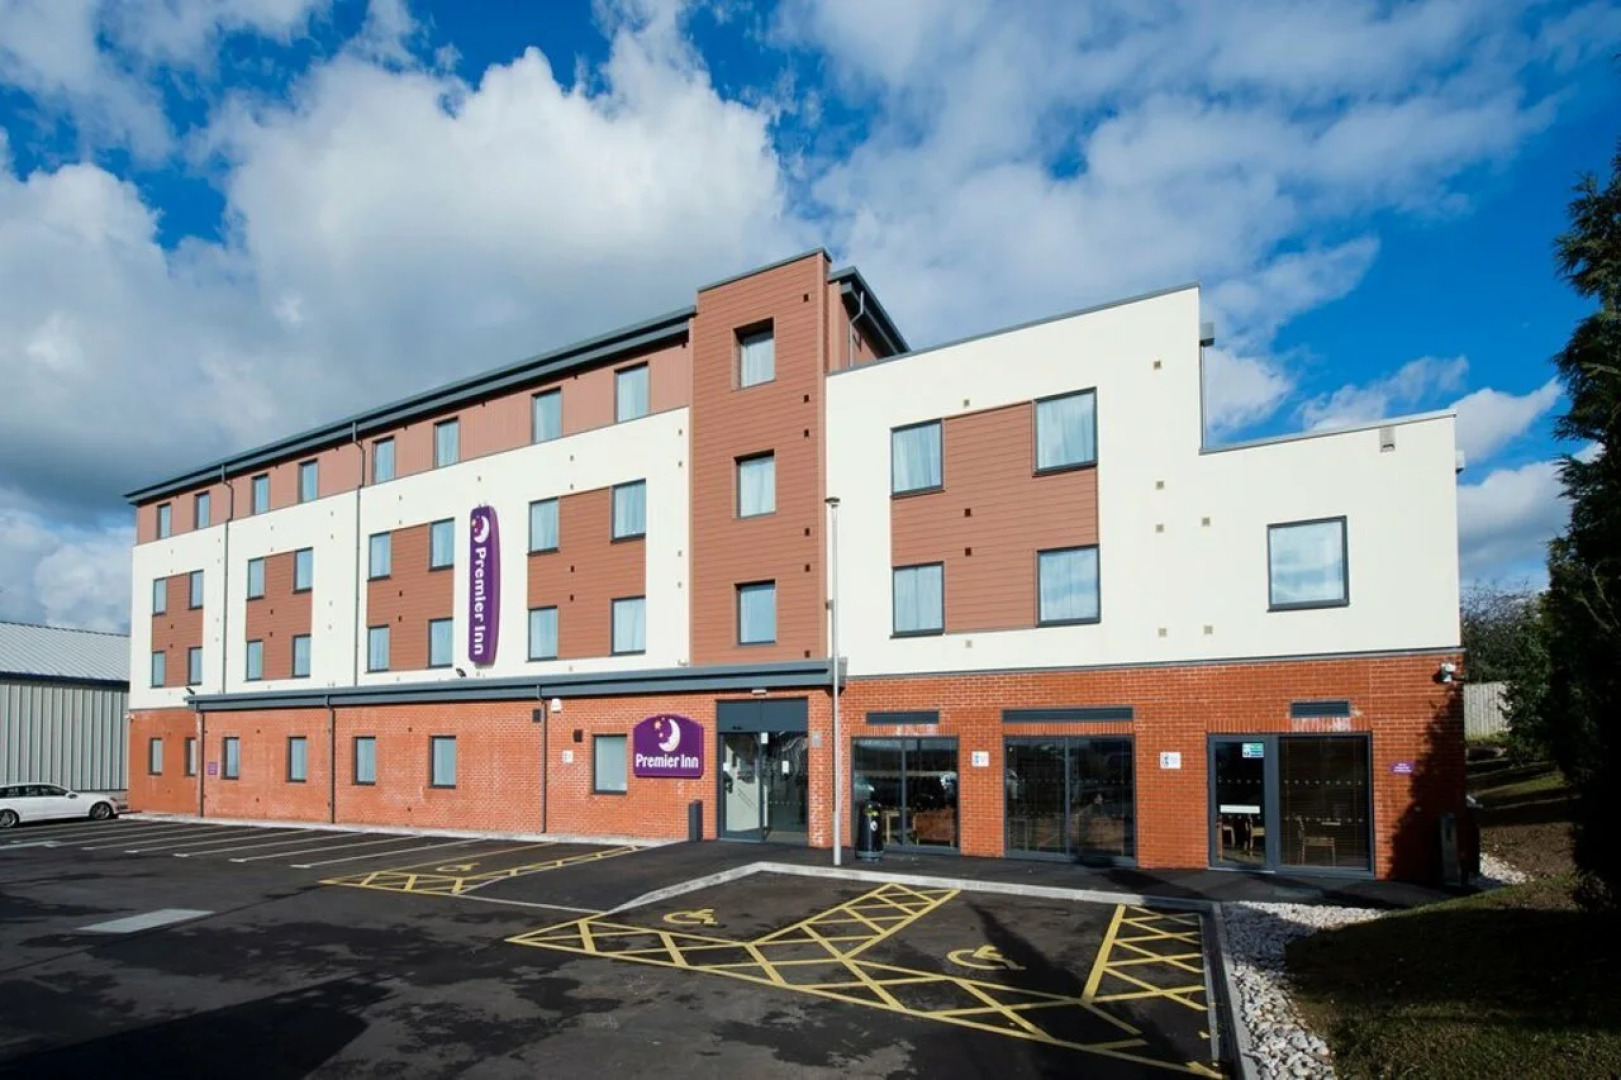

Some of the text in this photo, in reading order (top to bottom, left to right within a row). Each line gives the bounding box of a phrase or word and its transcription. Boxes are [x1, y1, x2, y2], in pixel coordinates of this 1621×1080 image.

[474, 547, 487, 655] Premier Inn
[635, 753, 699, 768] Premier Inn
